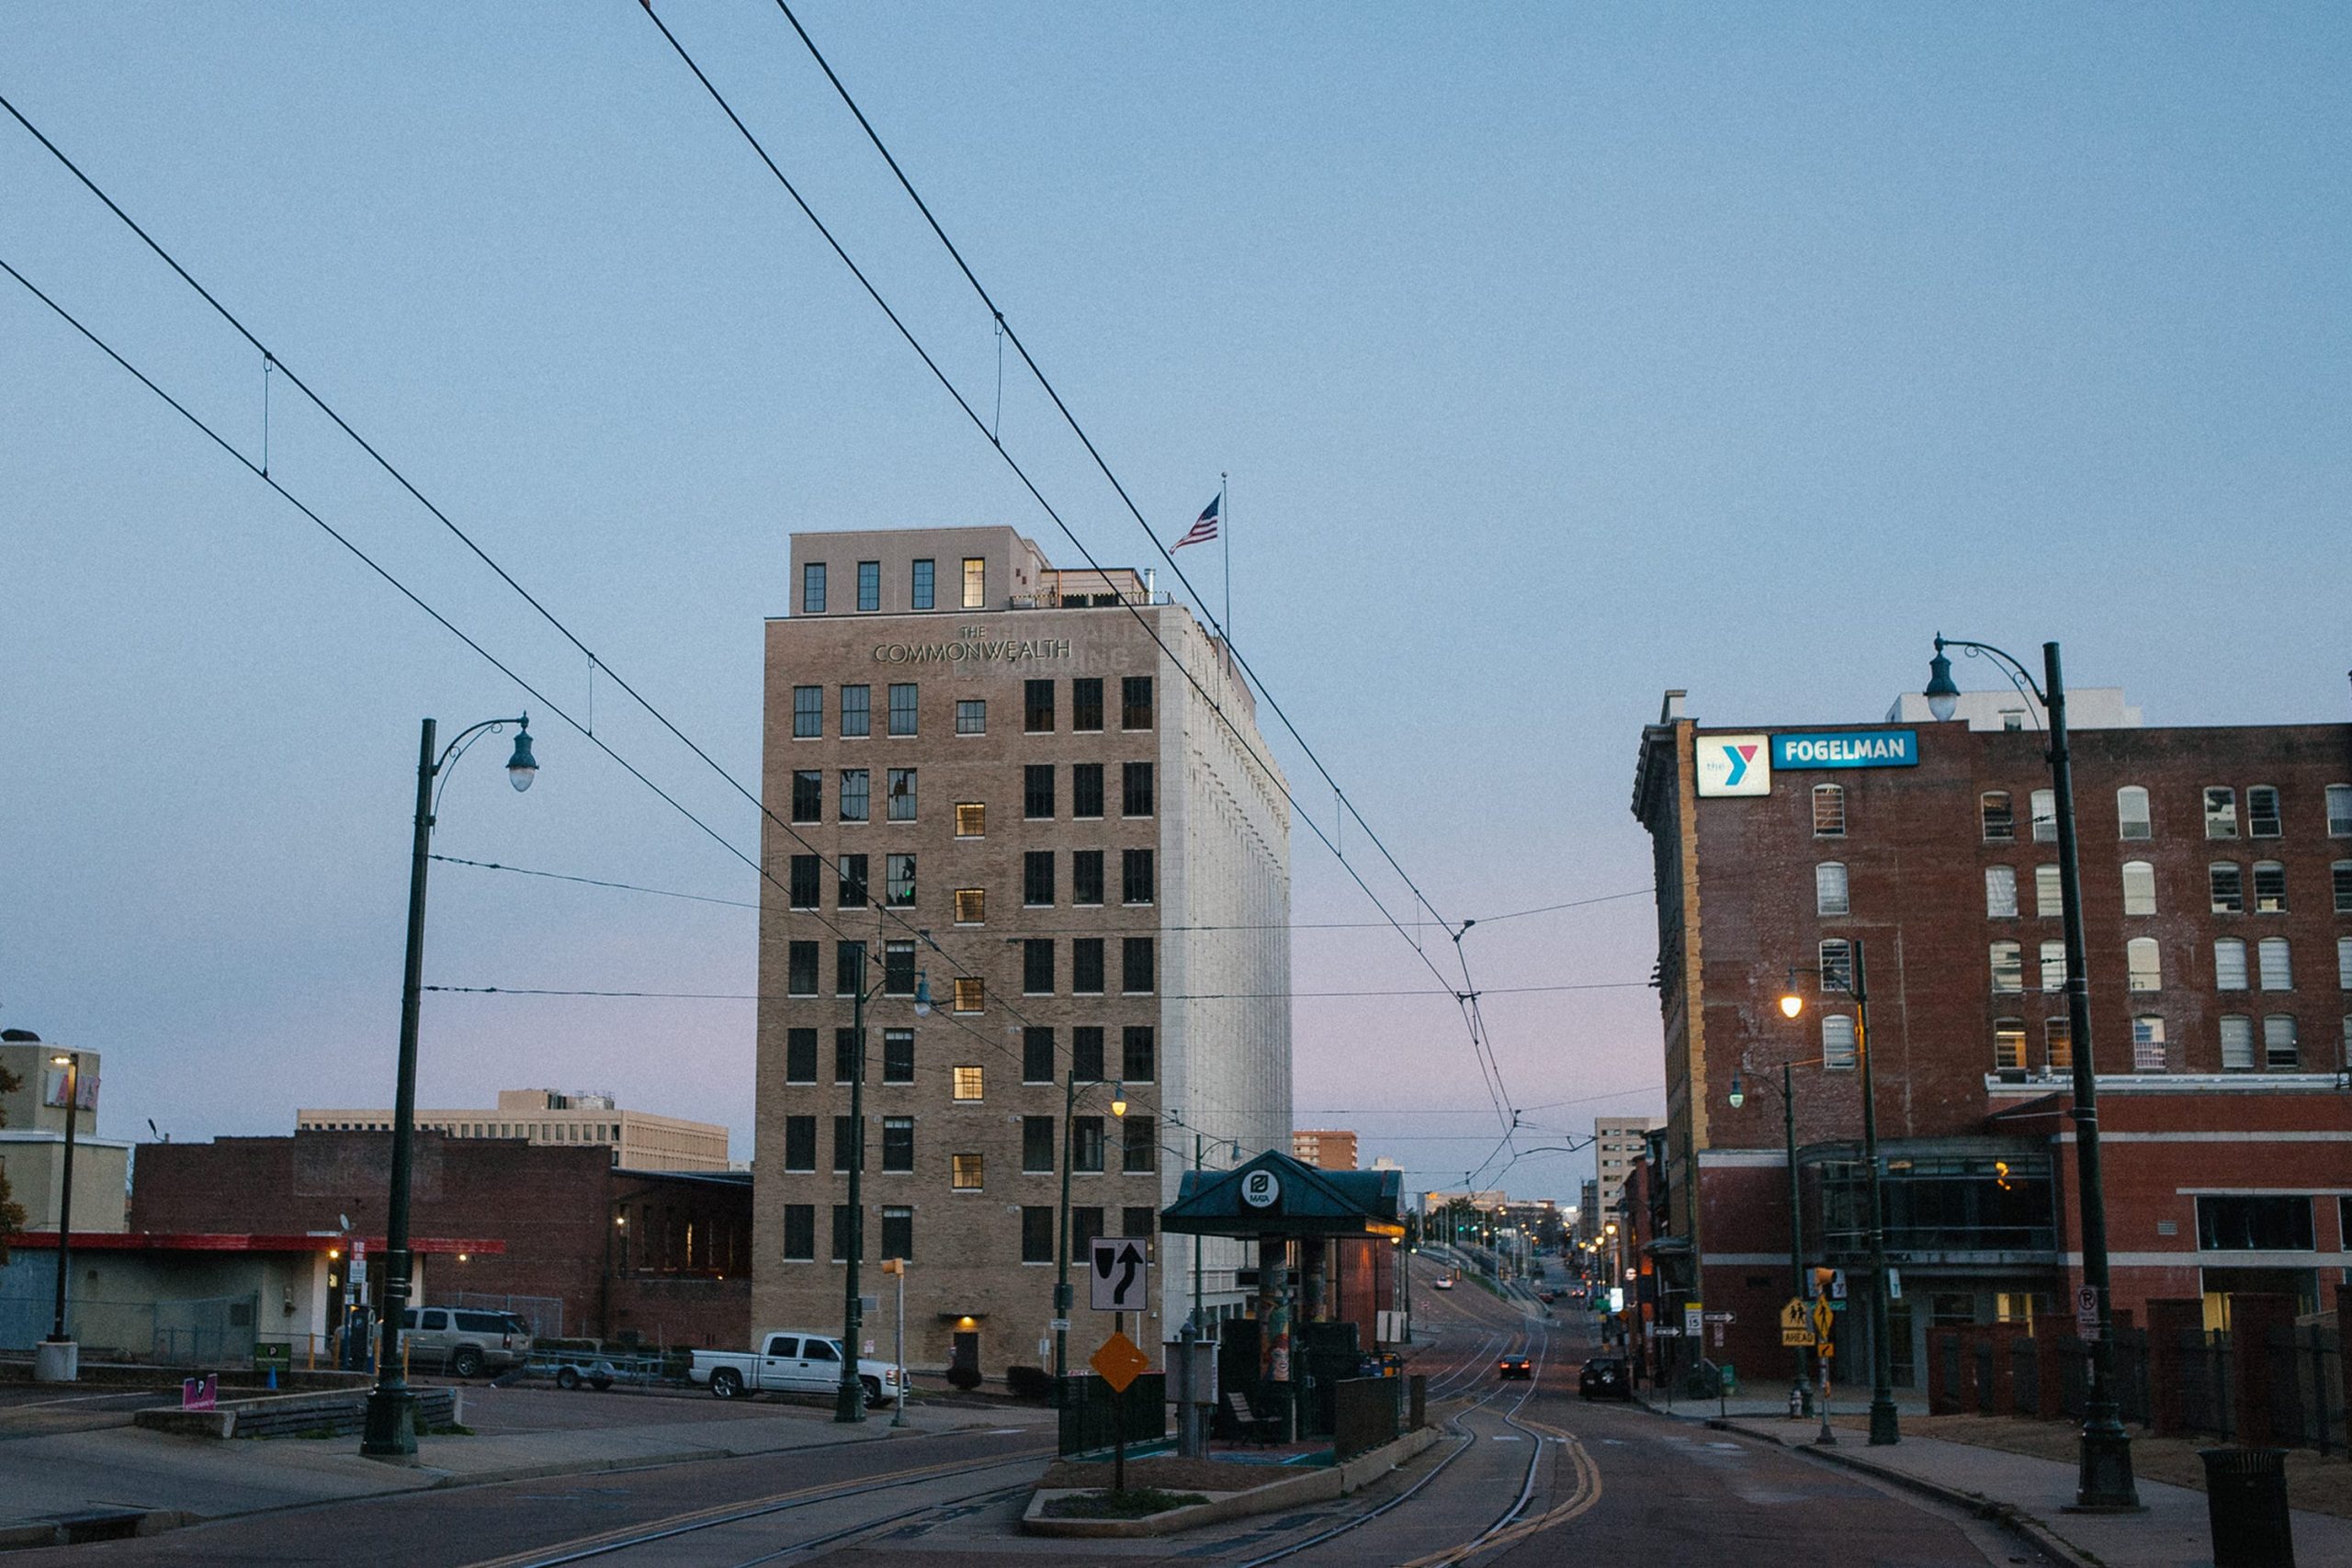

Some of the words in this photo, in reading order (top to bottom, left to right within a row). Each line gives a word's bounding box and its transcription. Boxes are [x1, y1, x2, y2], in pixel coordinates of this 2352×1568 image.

[961, 626, 986, 638] THE
[873, 639, 1072, 663] COMMONWEALTH
[1785, 738, 1905, 761] FOGELMAN
[1250, 1194, 1271, 1203] MATA
[1785, 1332, 1814, 1343] AHEAD
